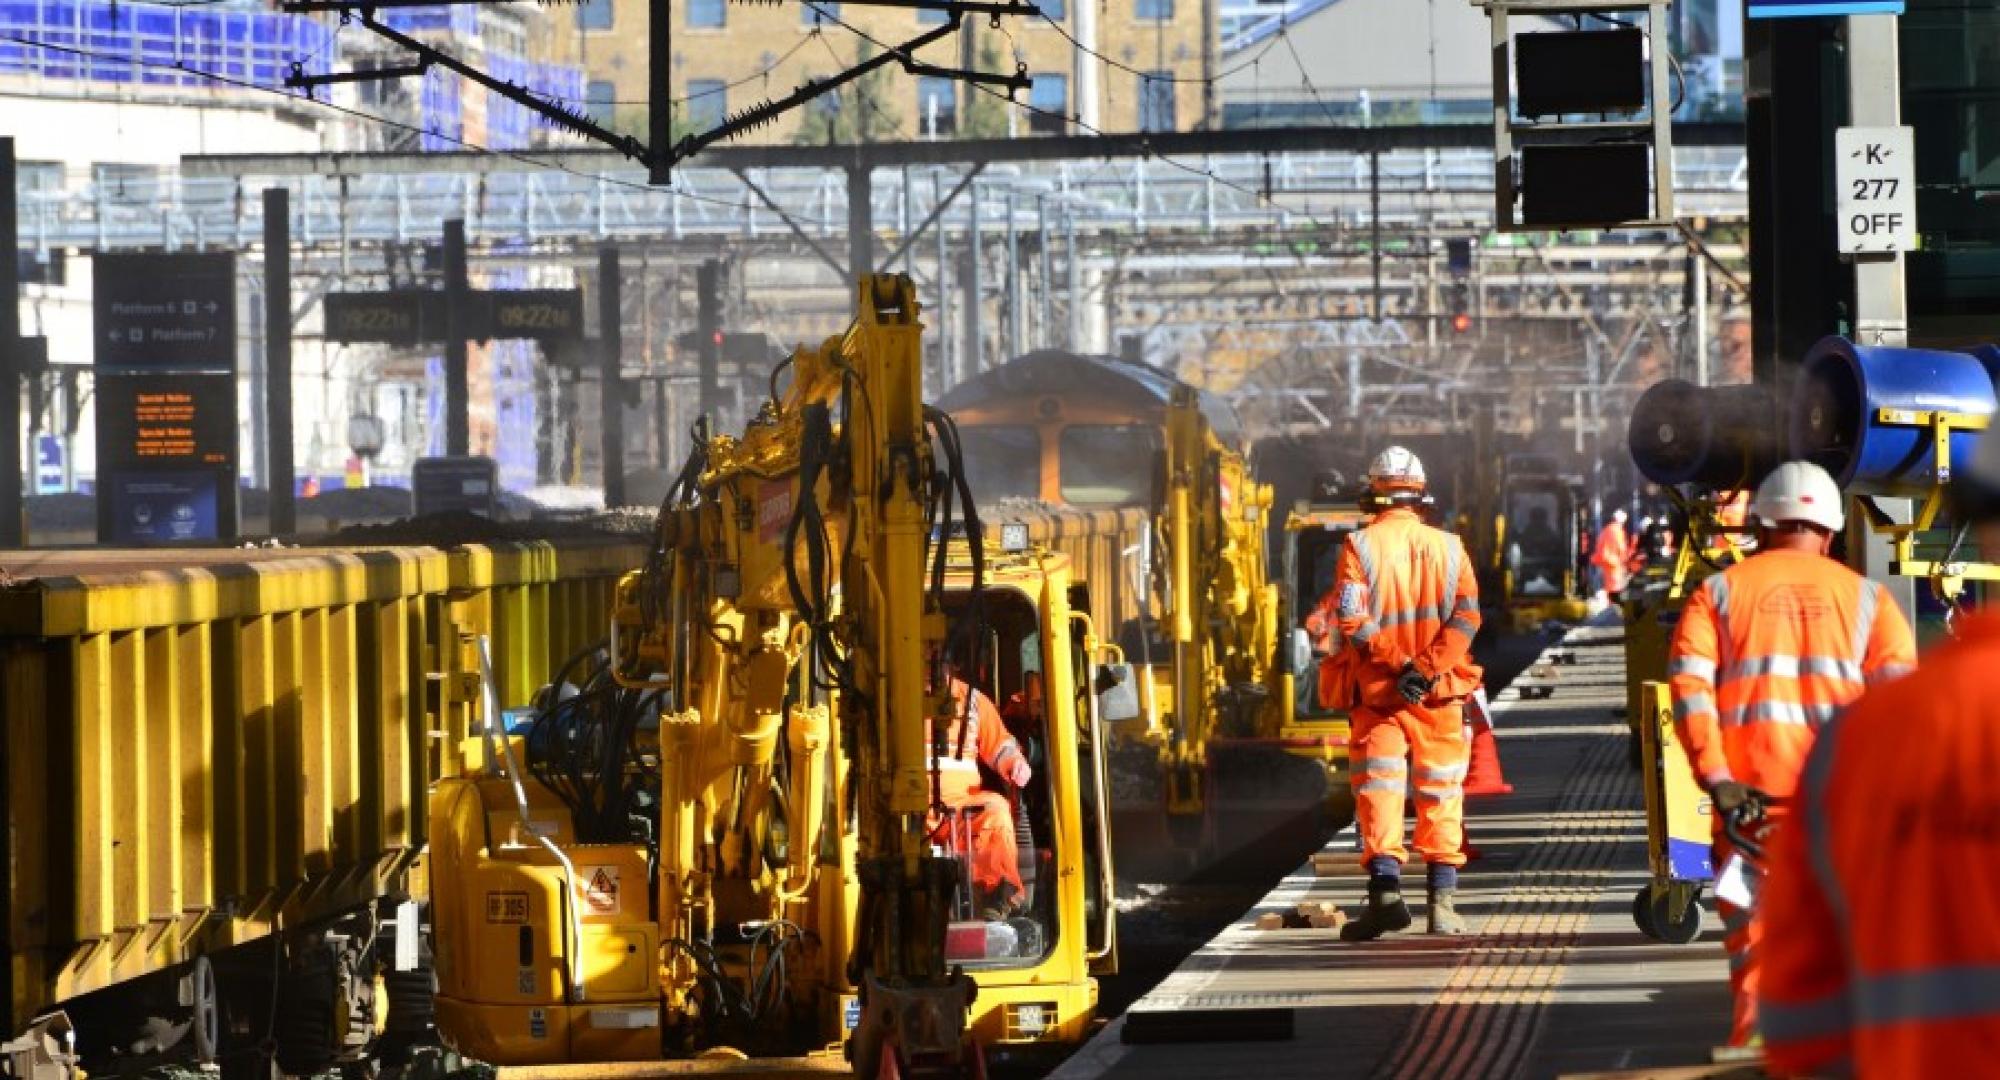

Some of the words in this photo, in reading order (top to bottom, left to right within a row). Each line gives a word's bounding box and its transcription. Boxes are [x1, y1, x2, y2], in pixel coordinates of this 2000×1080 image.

[1866, 144, 1883, 165] K
[1853, 179, 1899, 200] 277
[1851, 213, 1902, 235] OFF
[111, 302, 164, 313] Platform
[152, 327, 206, 340] Platform
[208, 327, 216, 341] 7
